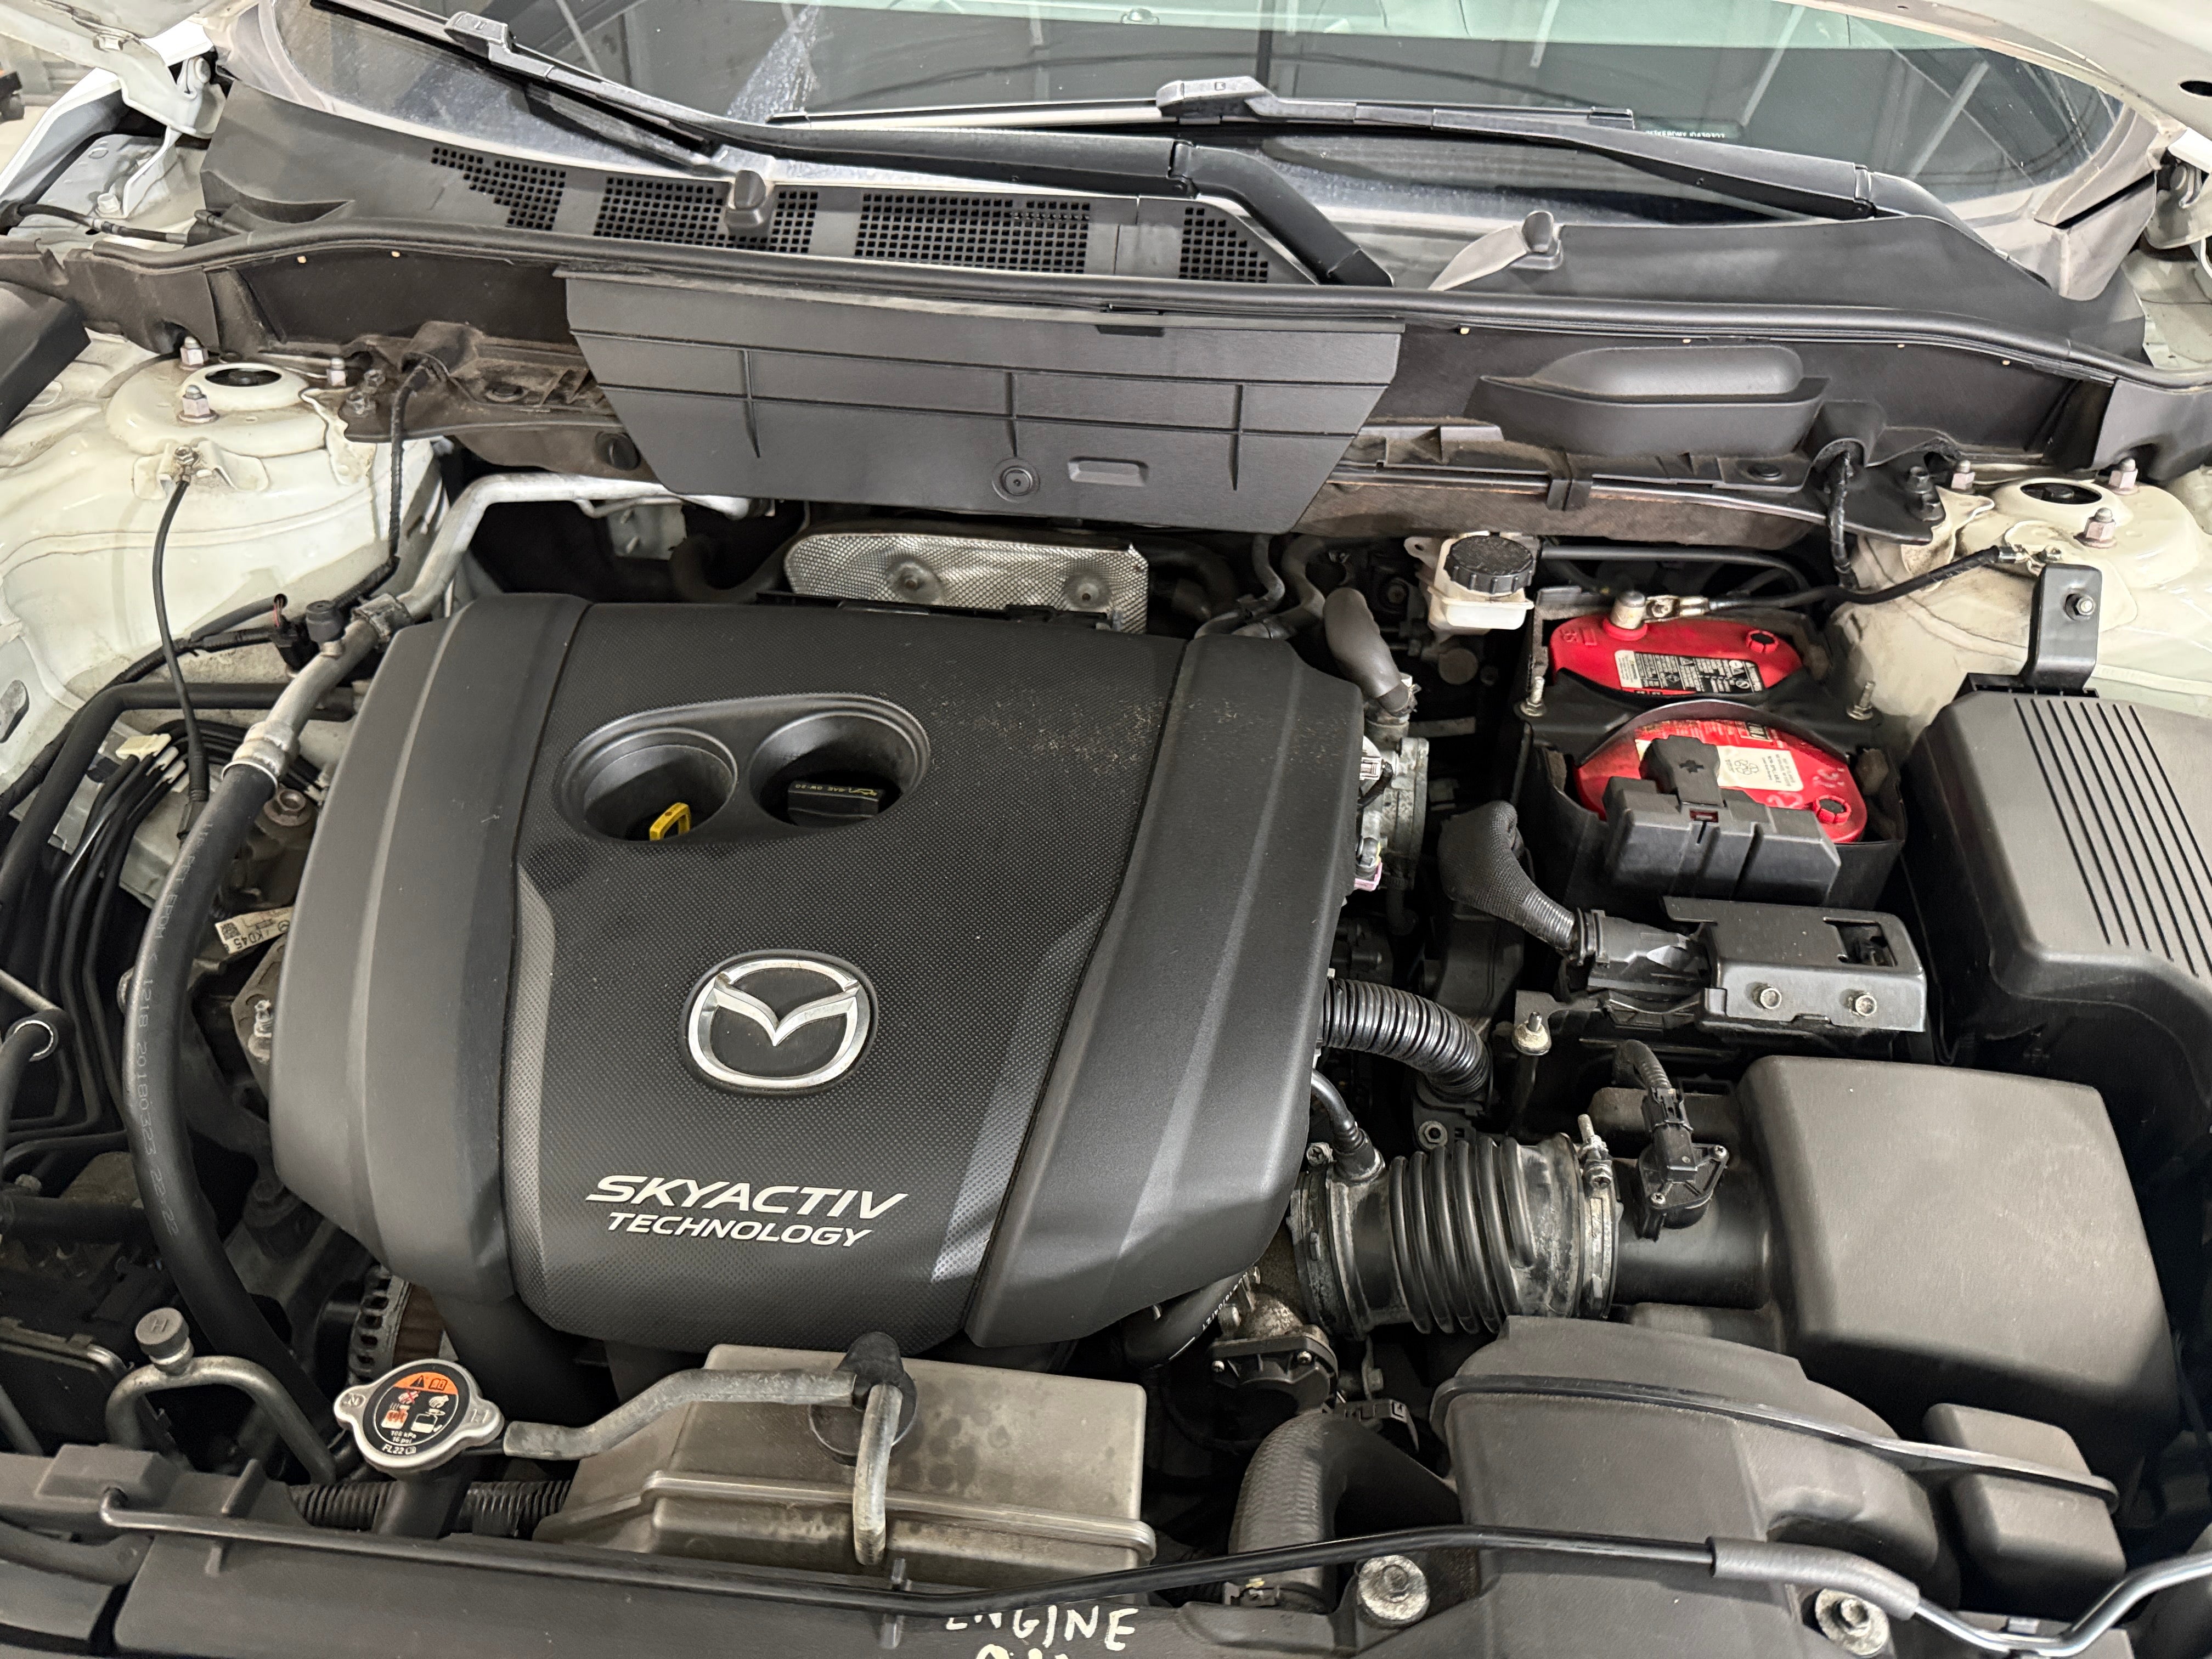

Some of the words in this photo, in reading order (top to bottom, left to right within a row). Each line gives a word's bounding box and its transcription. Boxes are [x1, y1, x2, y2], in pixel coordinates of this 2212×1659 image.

[139, 978, 154, 1028] 1218
[137, 1042, 156, 1155] 20180323
[585, 1174, 909, 1220] SKYACTIV
[608, 1212, 873, 1247] TECHNOLOGY
[150, 1319, 170, 1333] H
[382, 1443, 405, 1454] FL22
